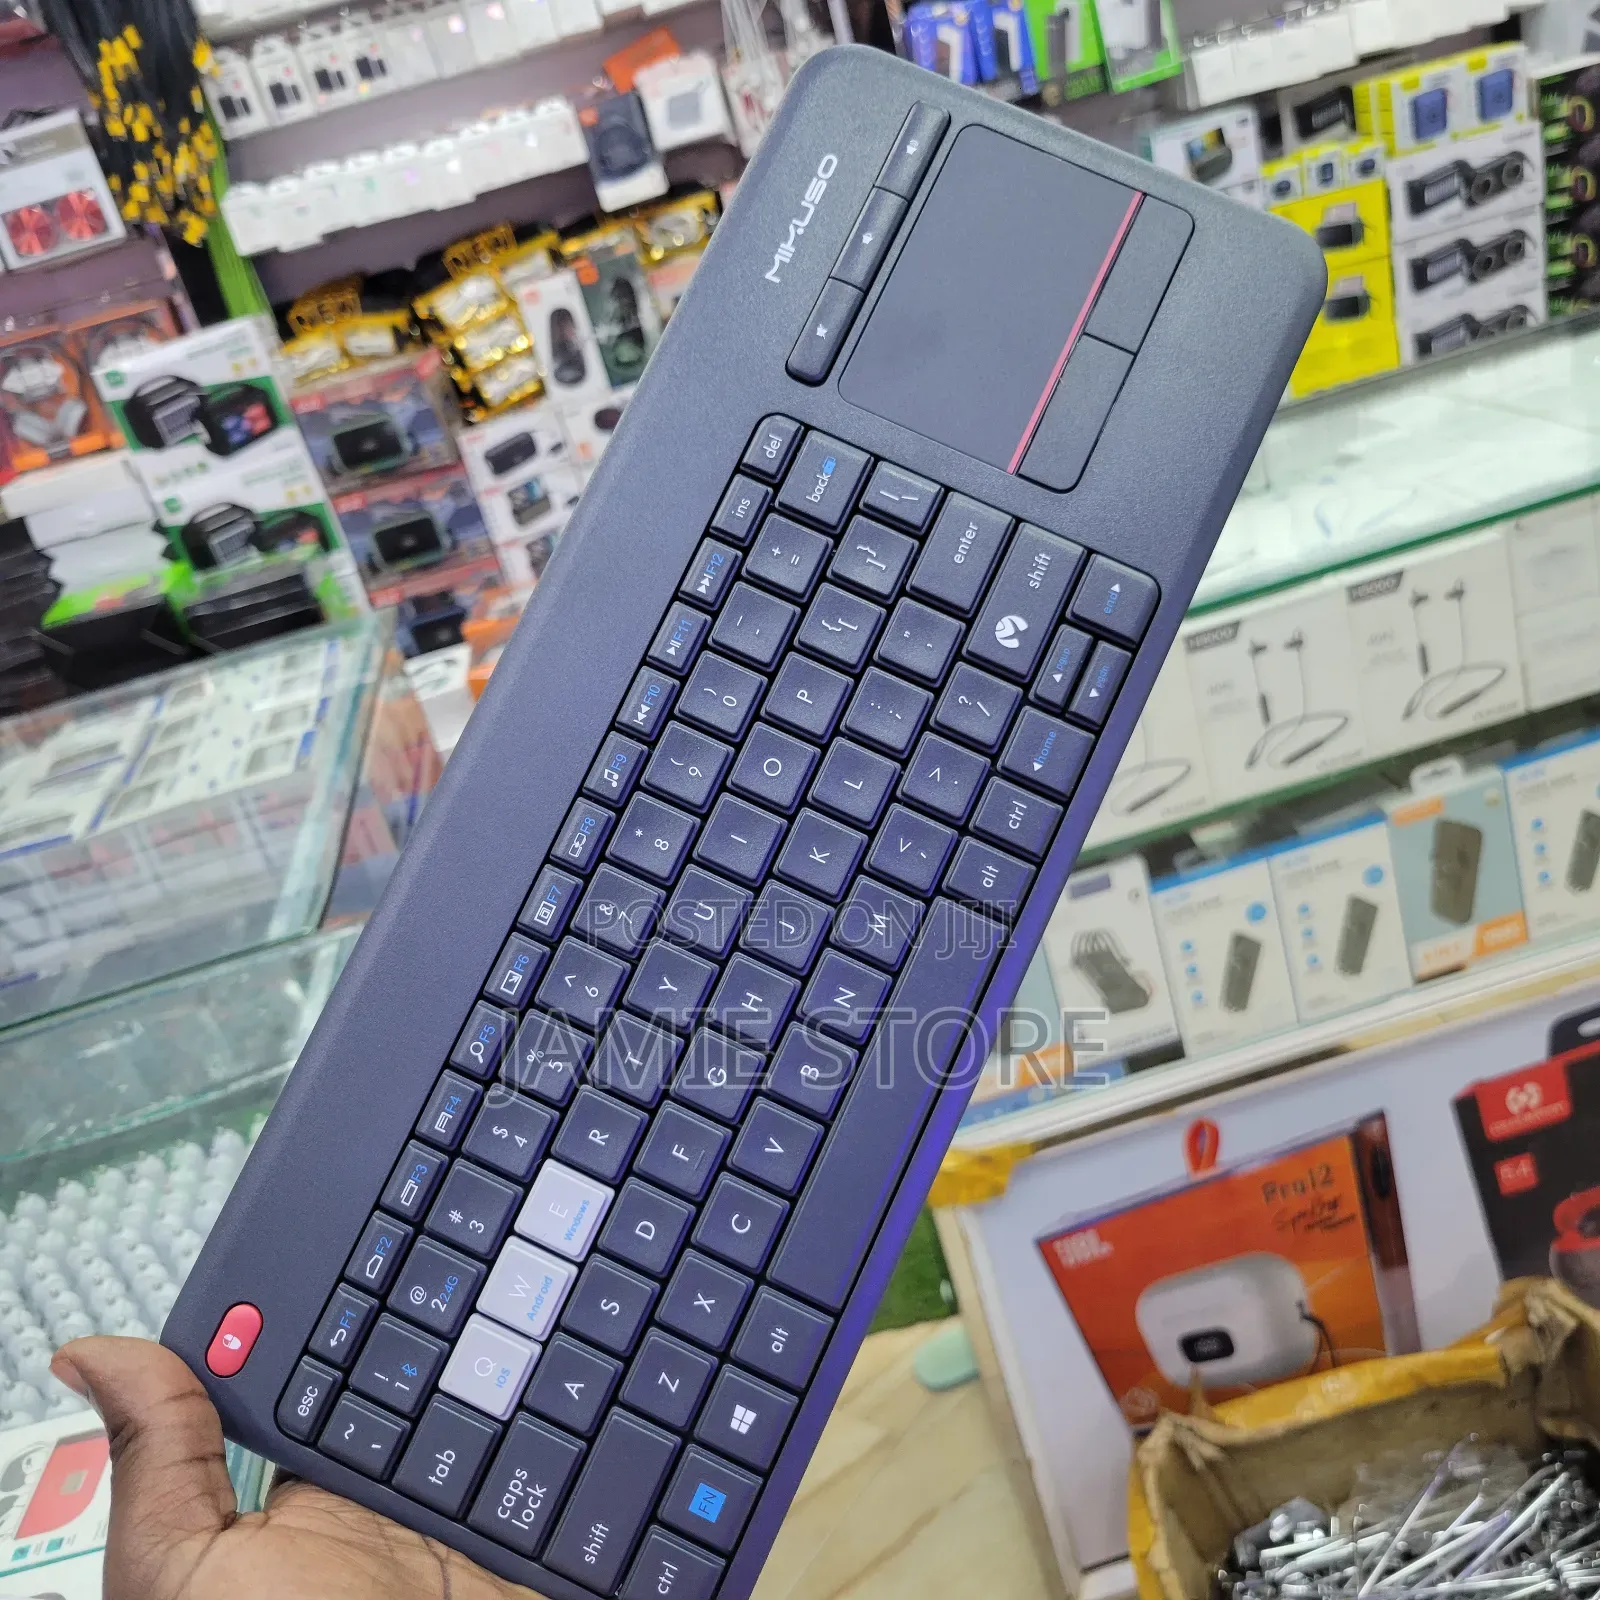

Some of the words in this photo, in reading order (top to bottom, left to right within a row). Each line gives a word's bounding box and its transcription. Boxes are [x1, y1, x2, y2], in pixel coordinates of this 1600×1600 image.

[763, 434, 783, 459] del
[806, 472, 831, 503] back
[732, 499, 750, 517] ins
[771, 546, 782, 557] +
[954, 522, 977, 563] enter
[705, 553, 725, 575] F12
[1028, 554, 1050, 588] shift
[1103, 591, 1117, 615] end
[672, 619, 692, 642] F11
[644, 684, 661, 705] F10
[703, 687, 717, 696] )
[797, 690, 812, 704] P
[958, 695, 972, 706] ?
[722, 695, 737, 707] 0
[1037, 731, 1057, 765] home
[612, 753, 628, 771] F9
[670, 757, 685, 766] (
[764, 758, 781, 776] O
[688, 766, 703, 778] 9
[928, 767, 941, 783] >
[843, 780, 864, 790] L
[1009, 801, 1026, 829] ctrl
[581, 817, 596, 834] F8
[654, 838, 670, 851] 8
[899, 837, 912, 853] <
[810, 847, 830, 863] K
[982, 866, 998, 887] alt
[546, 885, 562, 904] F7
[598, 903, 616, 916] &
[619, 911, 632, 924] 7
[694, 903, 714, 920] U
[779, 921, 794, 934] J
[868, 914, 890, 935] M
[514, 955, 530, 973] F6
[584, 985, 599, 998] 6
[659, 977, 677, 991] Y
[742, 992, 762, 1012] H
[834, 987, 856, 1008] N
[480, 1025, 496, 1044] F5
[527, 1049, 544, 1063] %
[625, 1051, 643, 1065] T
[548, 1059, 563, 1072] 5
[800, 1065, 819, 1080] B
[708, 1067, 726, 1087] G
[446, 1095, 462, 1114] F4
[493, 1126, 508, 1138] $
[515, 1135, 527, 1147] 4
[589, 1130, 609, 1145] R
[672, 1144, 689, 1161] F
[765, 1138, 784, 1152] V
[411, 1164, 428, 1183] F3
[449, 1210, 463, 1223] #
[549, 1203, 568, 1218] E
[470, 1220, 484, 1233] 3
[564, 1200, 589, 1241] Windows
[732, 1214, 751, 1233] C
[635, 1221, 655, 1240] D
[376, 1237, 393, 1255] F2
[410, 1286, 426, 1304] @
[431, 1299, 446, 1312] 2
[440, 1275, 459, 1303] 2.4G
[508, 1275, 531, 1297] W
[527, 1276, 553, 1321] Android
[601, 1299, 619, 1315] S
[694, 1293, 715, 1312] X
[340, 1310, 356, 1329] F1
[771, 1328, 788, 1352] alt
[475, 1357, 496, 1376] Q
[374, 1372, 389, 1382] !
[394, 1381, 410, 1391] 1
[658, 1372, 679, 1392] Z
[565, 1383, 584, 1400] A
[298, 1386, 318, 1416] esc
[429, 1450, 455, 1485] tab
[498, 1469, 529, 1520] caps
[698, 1491, 717, 1515] FN
[511, 1482, 546, 1529] lock
[584, 1524, 608, 1563] shift
[658, 1562, 677, 1594] ctrl
